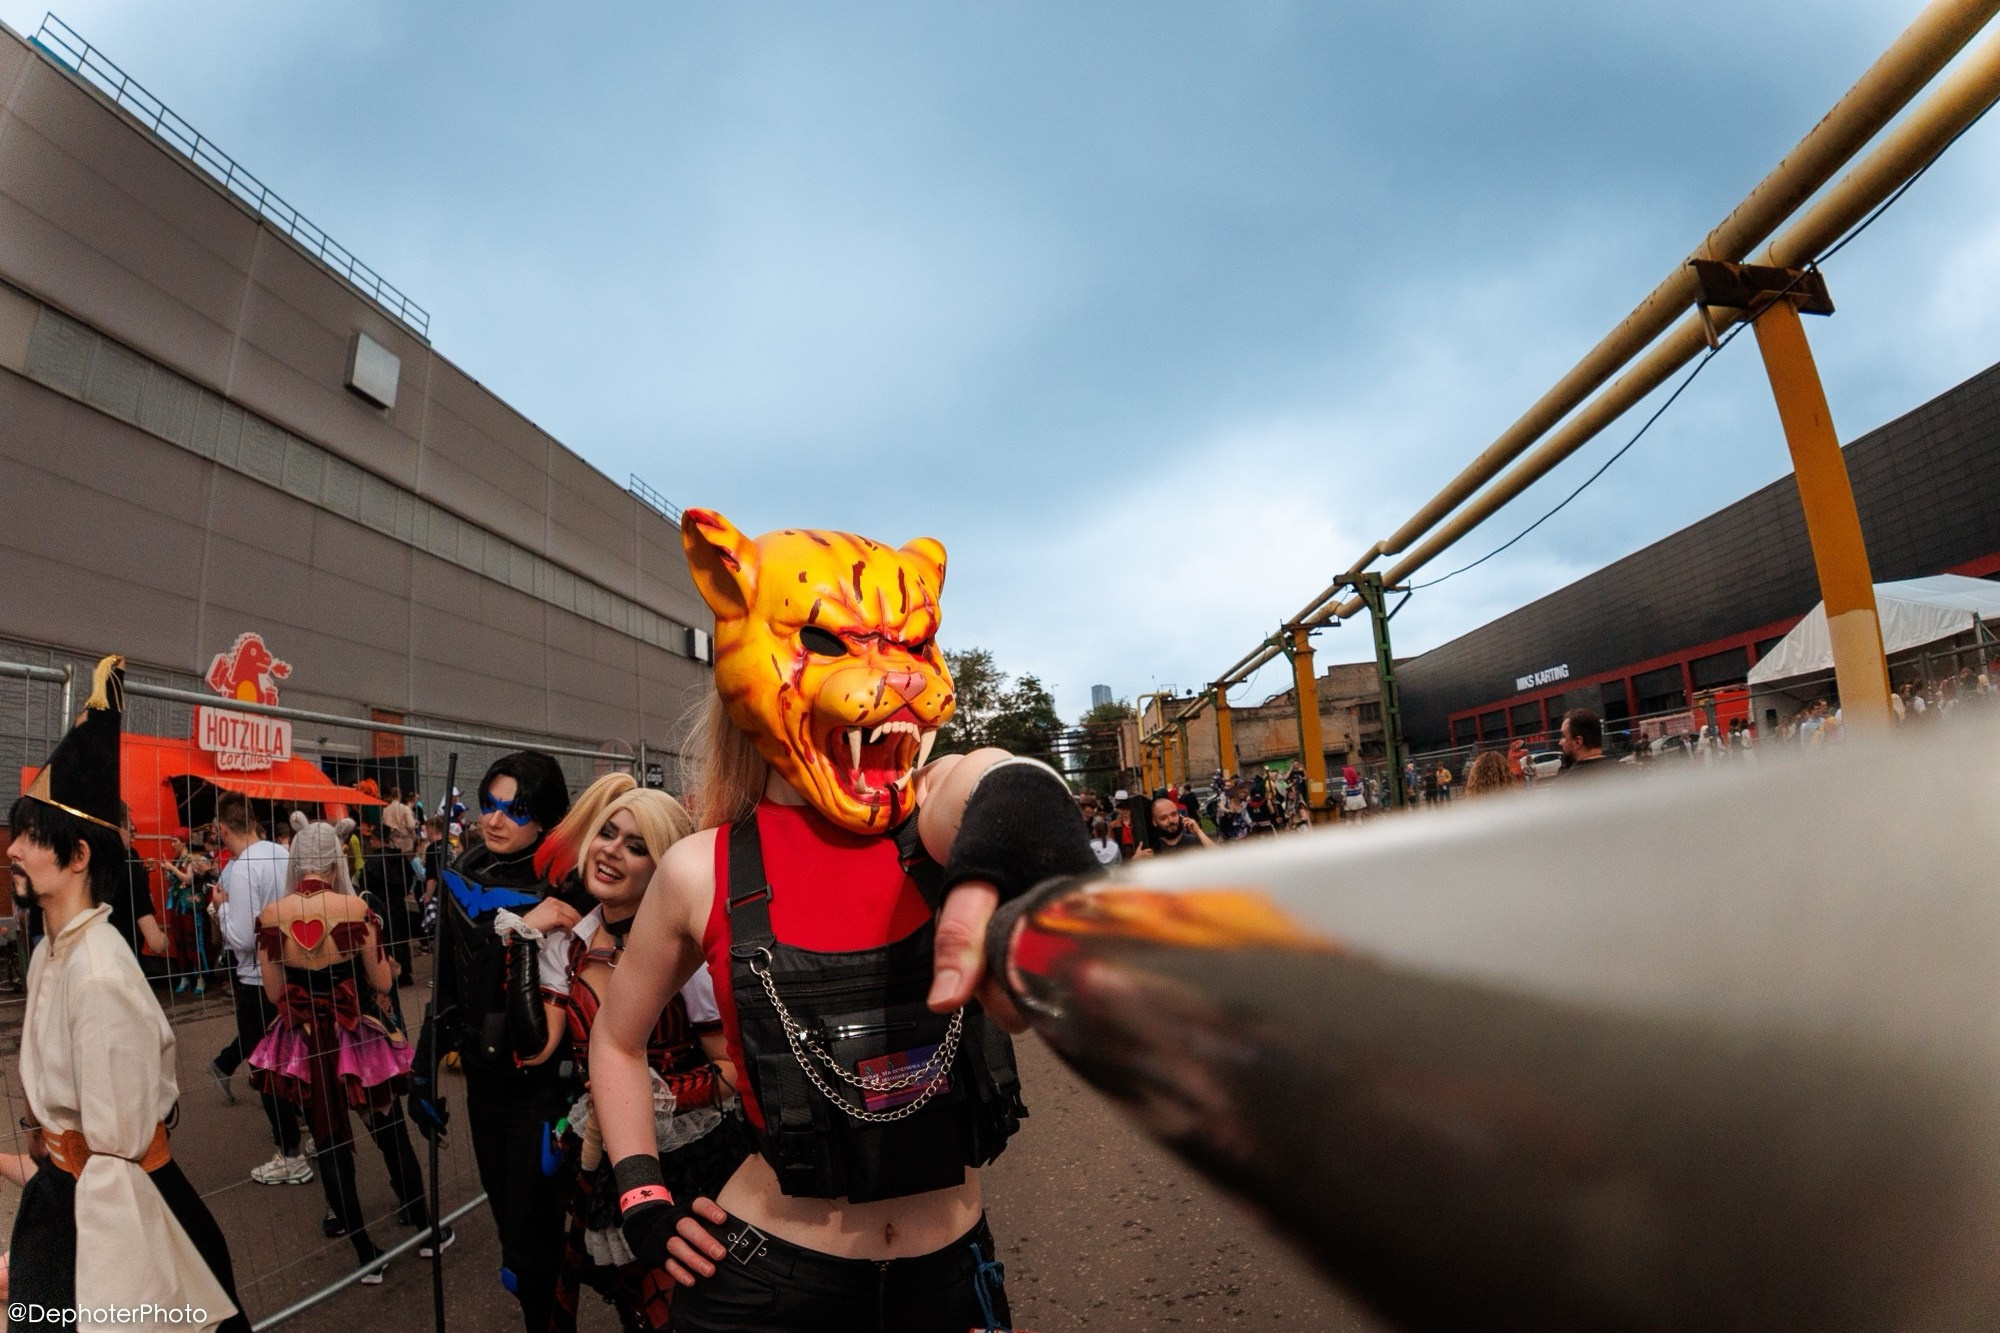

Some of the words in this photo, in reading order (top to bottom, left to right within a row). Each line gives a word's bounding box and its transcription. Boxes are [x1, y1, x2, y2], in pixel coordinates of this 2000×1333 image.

[1534, 664, 1570, 686] KARTING
[206, 713, 284, 756] HOTZILLA
[219, 748, 272, 767] tortillas
